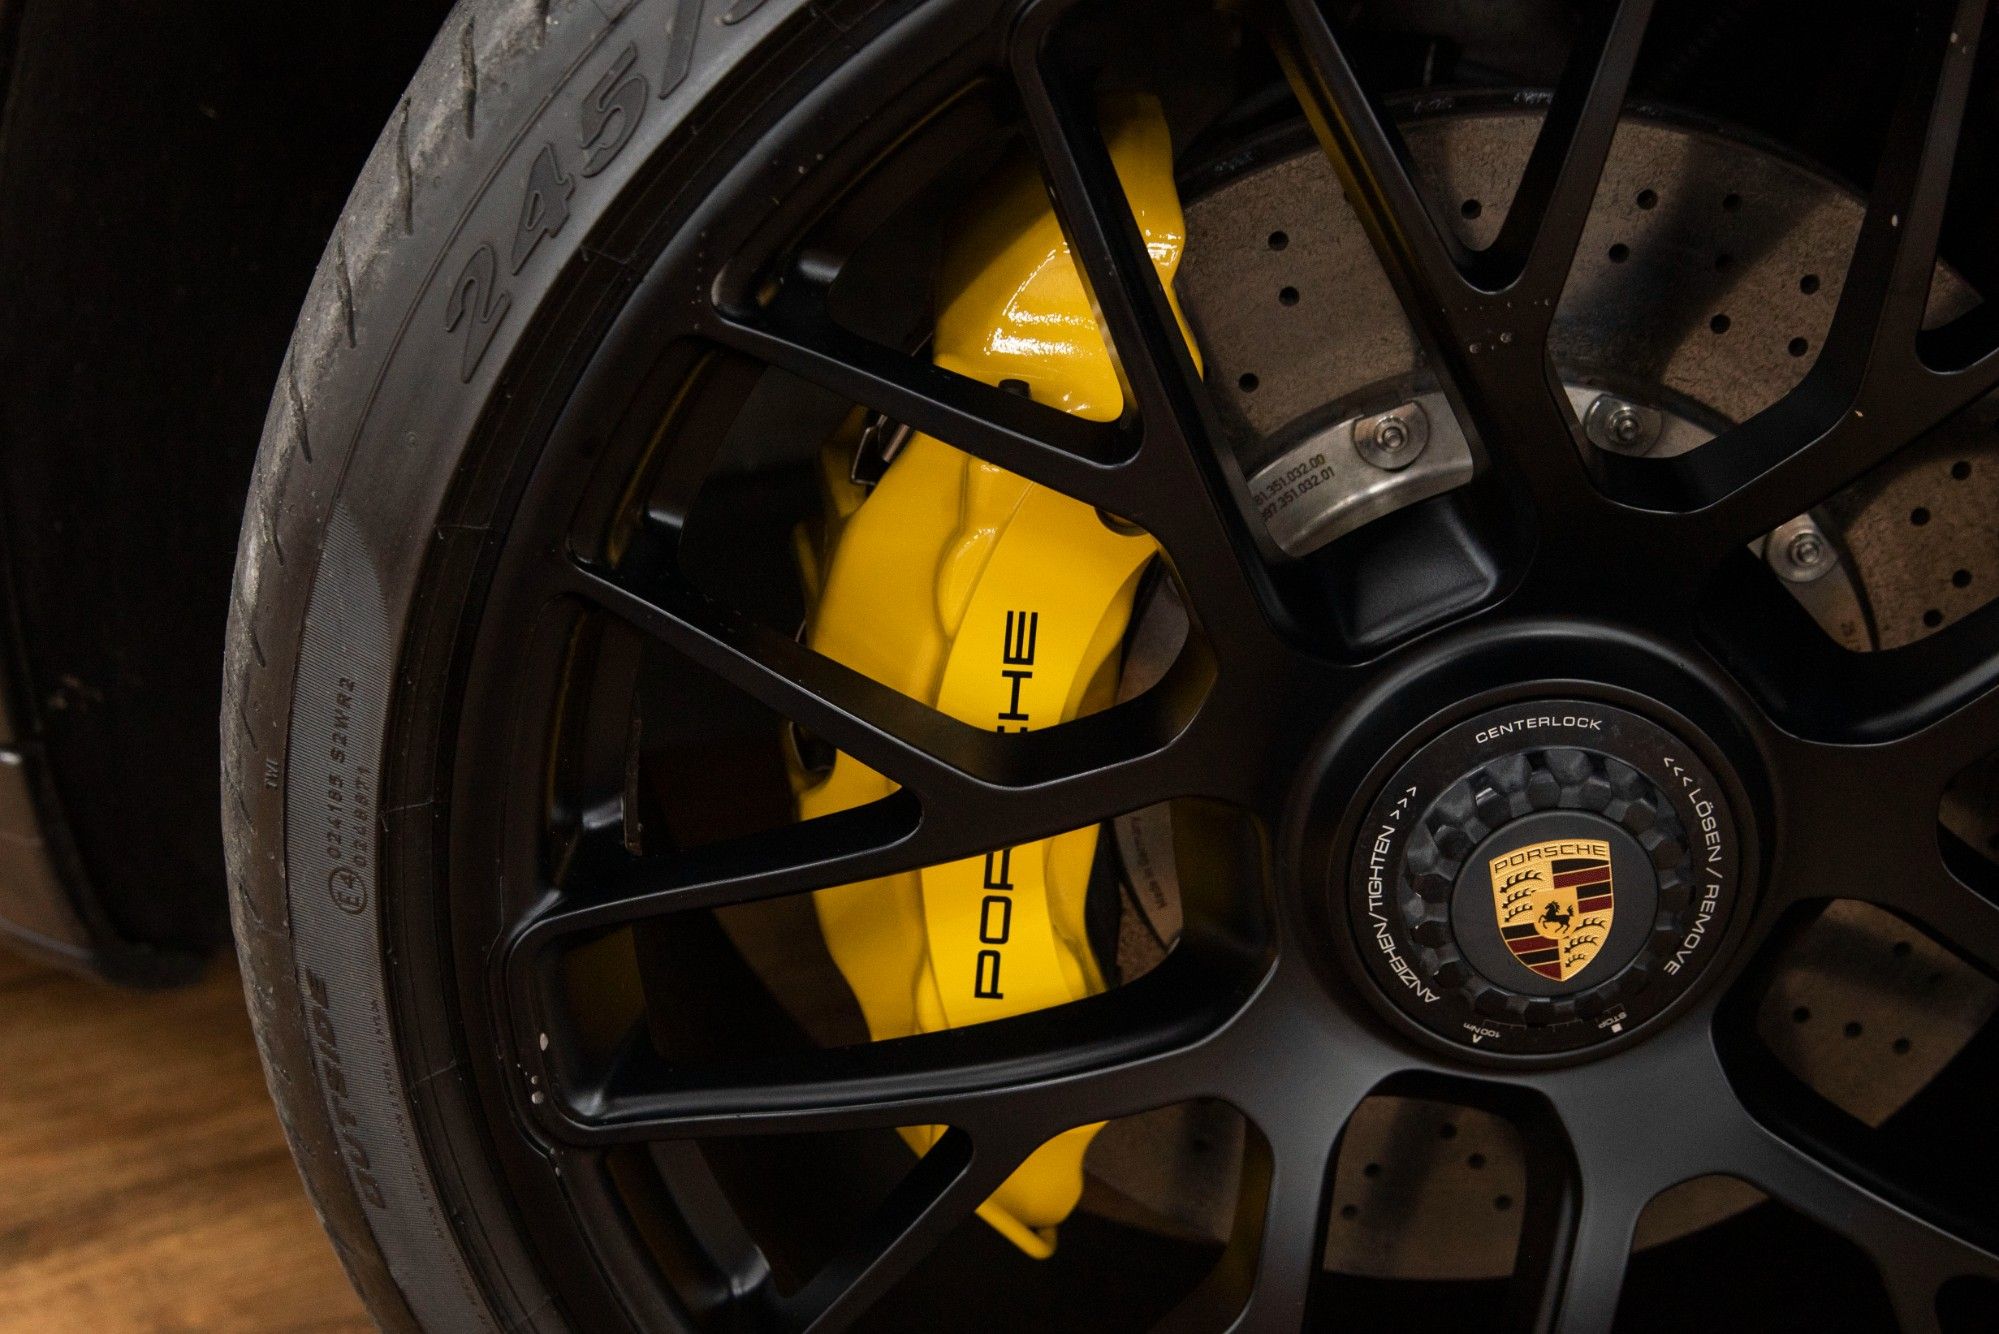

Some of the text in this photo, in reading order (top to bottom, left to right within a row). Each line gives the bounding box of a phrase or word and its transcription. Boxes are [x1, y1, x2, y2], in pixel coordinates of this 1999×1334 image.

[1475, 716, 1602, 744] CENTERLOCK
[1494, 844, 1605, 874] PORSCHE
[1688, 788, 1722, 863] LÖSEN
[1368, 825, 1440, 1003] ANZIEHEN/TIGHTEN
[1663, 884, 1720, 976] REMOVE
[1598, 1011, 1628, 1029] STOP
[305, 966, 387, 1209] OUTSIDE
